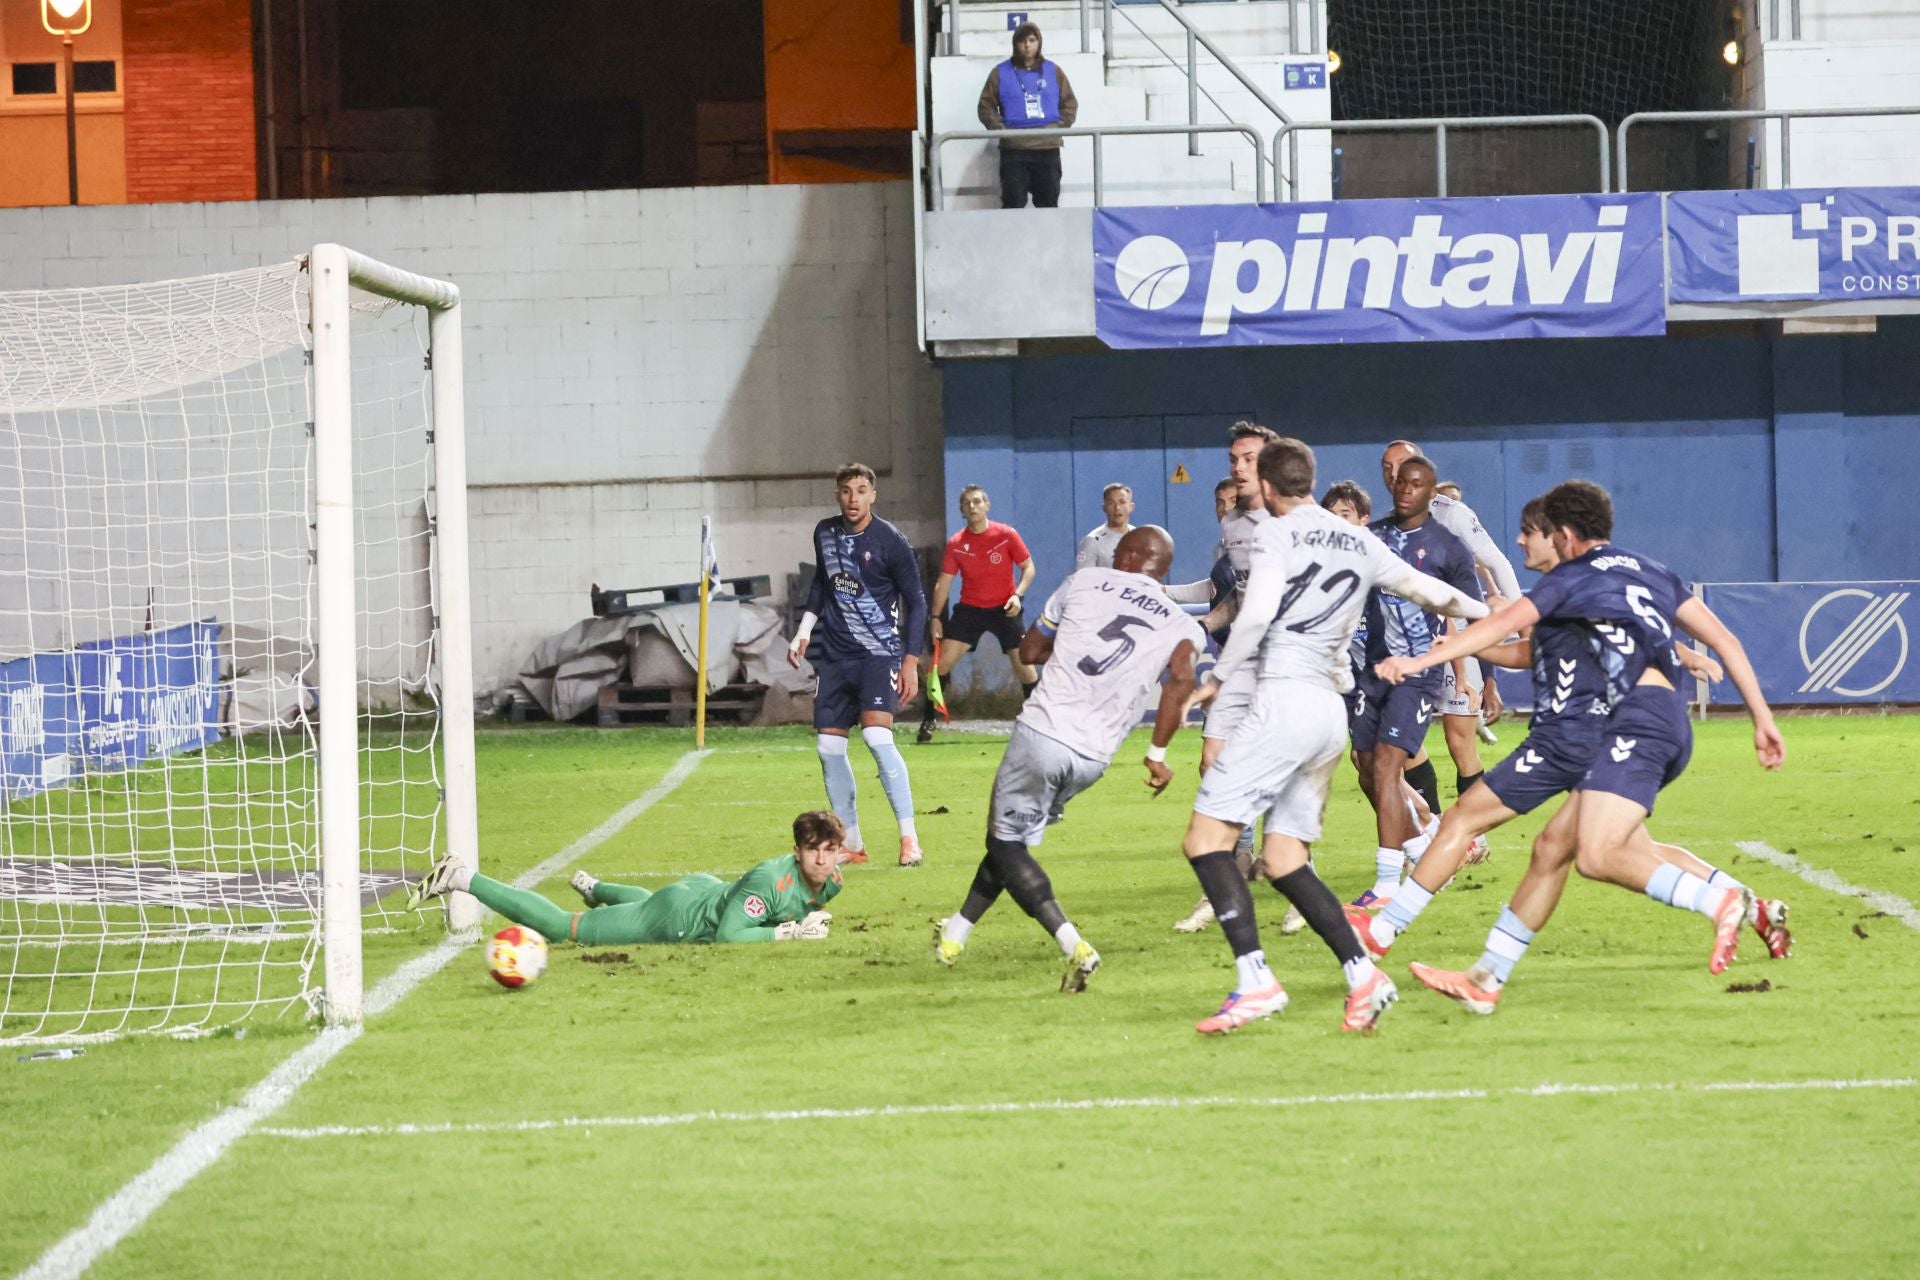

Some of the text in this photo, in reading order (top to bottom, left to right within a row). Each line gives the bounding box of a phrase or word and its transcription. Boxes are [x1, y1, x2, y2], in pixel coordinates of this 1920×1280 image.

[1308, 74, 1317, 85] K
[1200, 205, 1628, 336] pintavi
[834, 576, 859, 589] Estrella
[835, 583, 857, 596] Galicia
[1270, 561, 1361, 635] 12
[1625, 585, 1672, 640] 5
[1077, 614, 1156, 677] 5
[1354, 689, 1366, 716] 3
